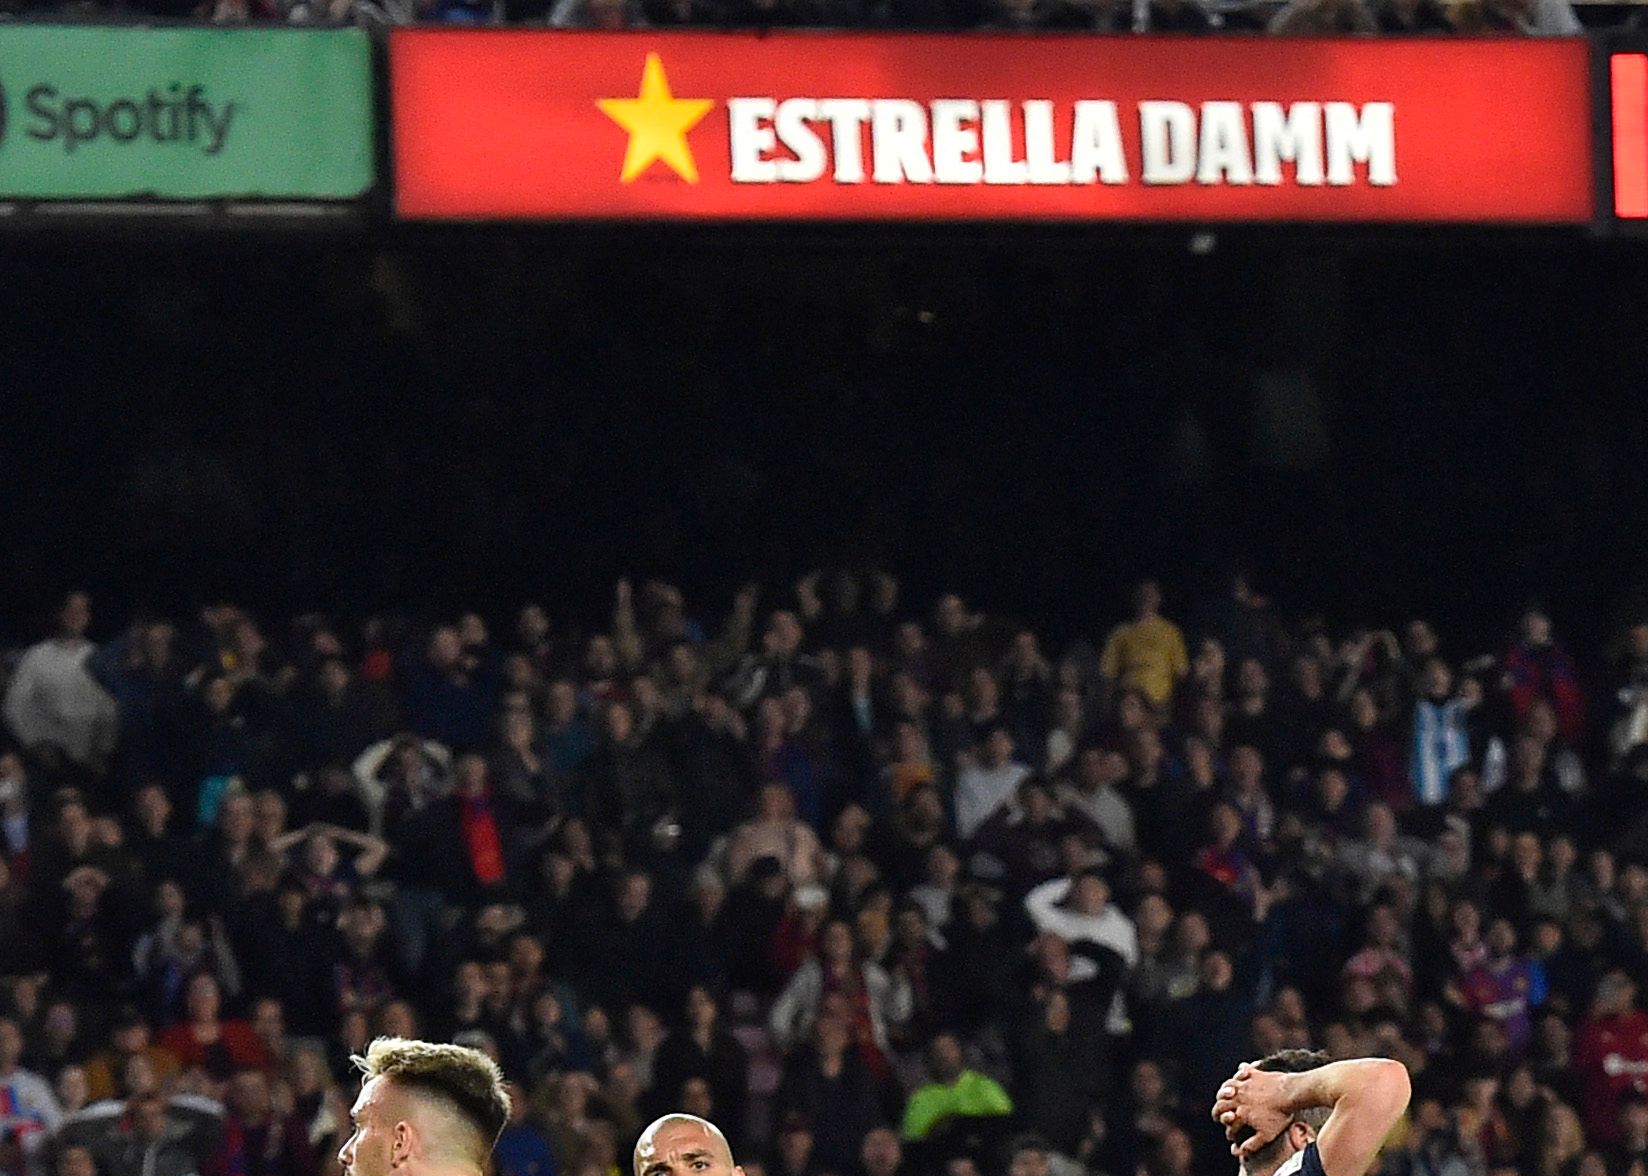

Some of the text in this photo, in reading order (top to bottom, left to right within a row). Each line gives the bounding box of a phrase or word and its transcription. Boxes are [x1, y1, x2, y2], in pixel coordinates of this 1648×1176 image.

[25, 82, 237, 156] Spotify
[726, 97, 1398, 187] ESTRELLA DAMM
